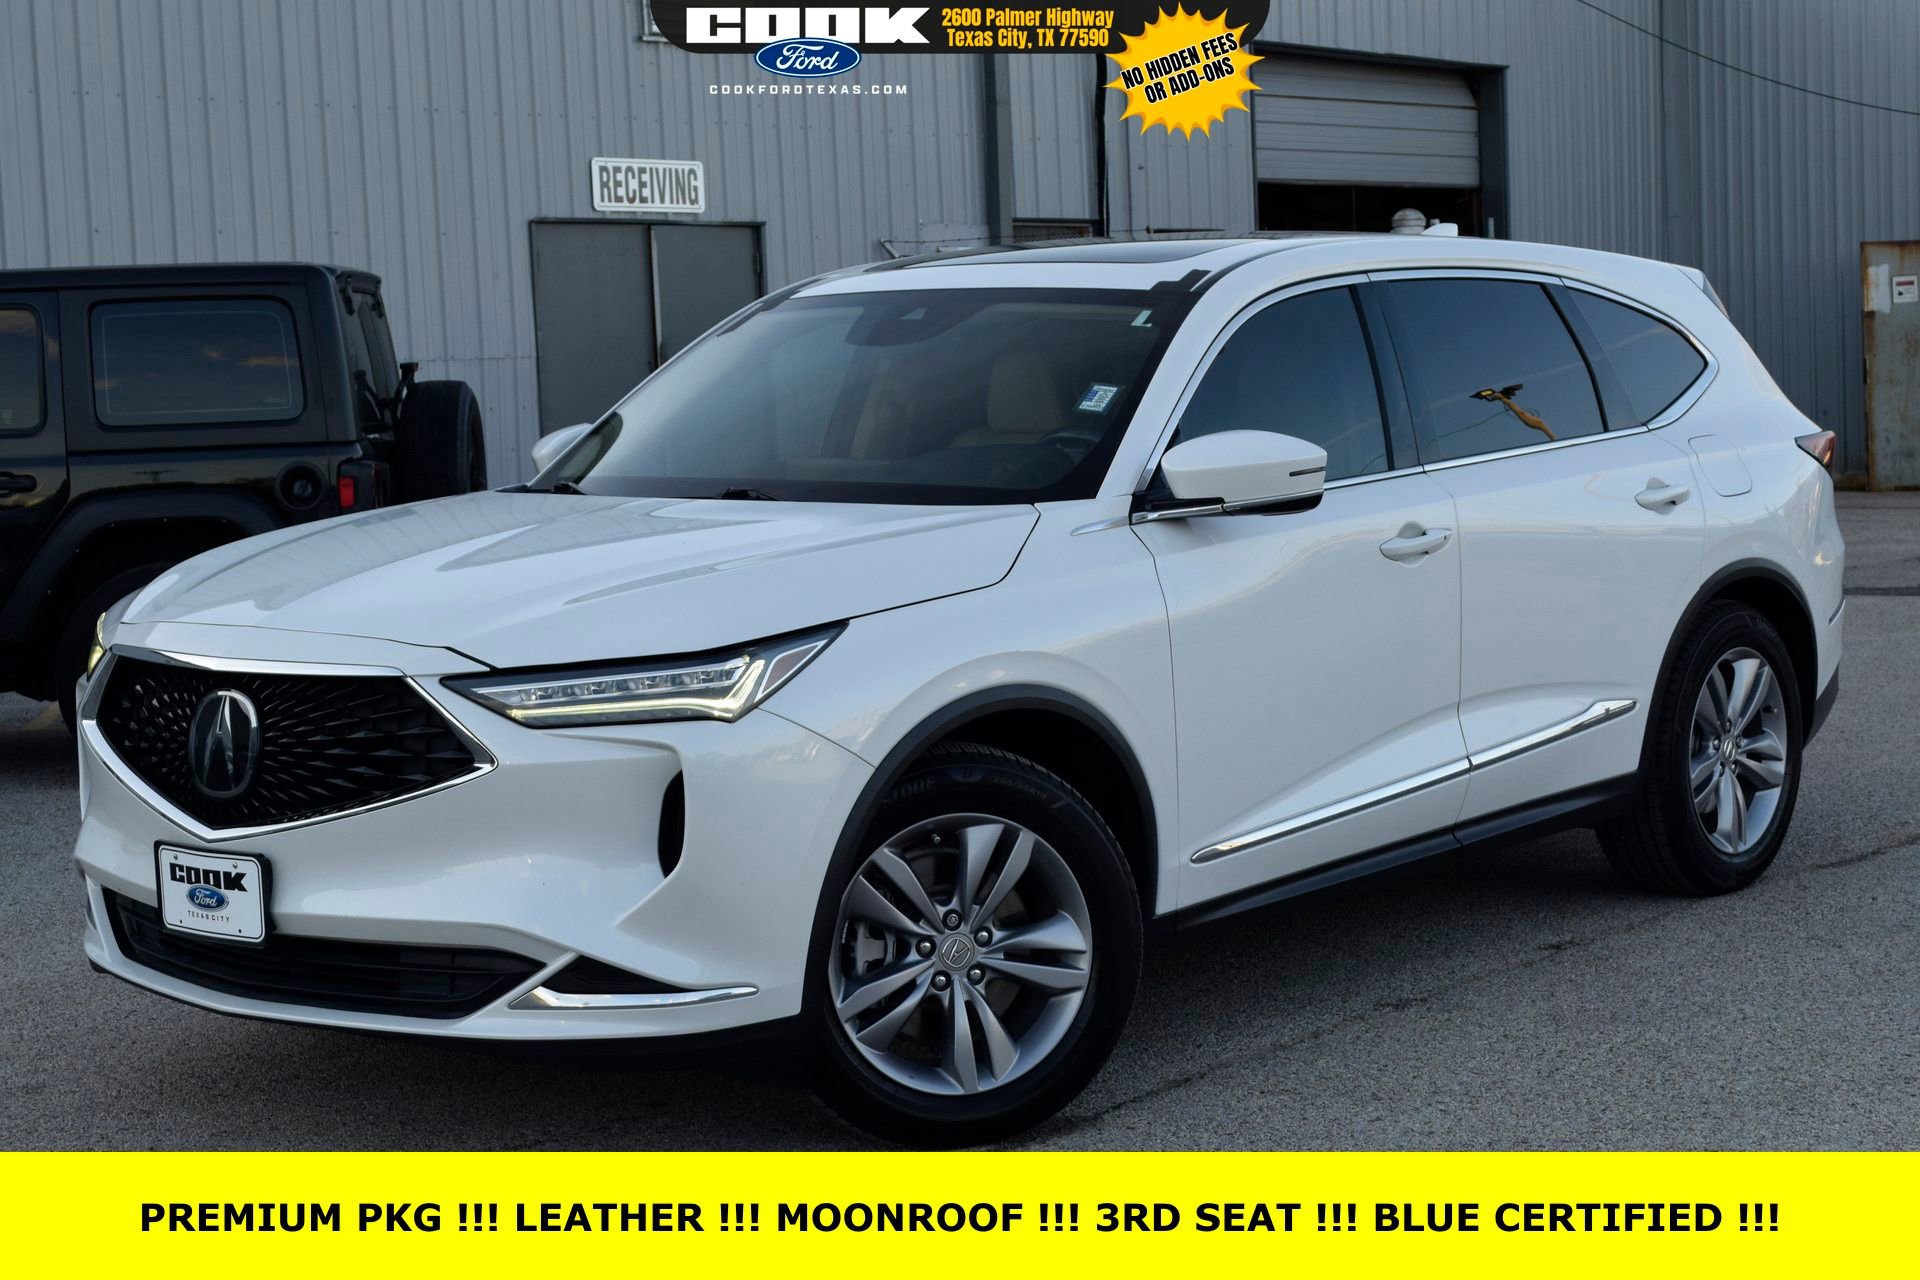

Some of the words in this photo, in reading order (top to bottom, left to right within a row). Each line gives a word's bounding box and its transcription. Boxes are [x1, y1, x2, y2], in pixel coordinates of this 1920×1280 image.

[598, 165, 700, 206] RECEIVING
[169, 862, 248, 892] COOK
[194, 888, 218, 907] Ford
